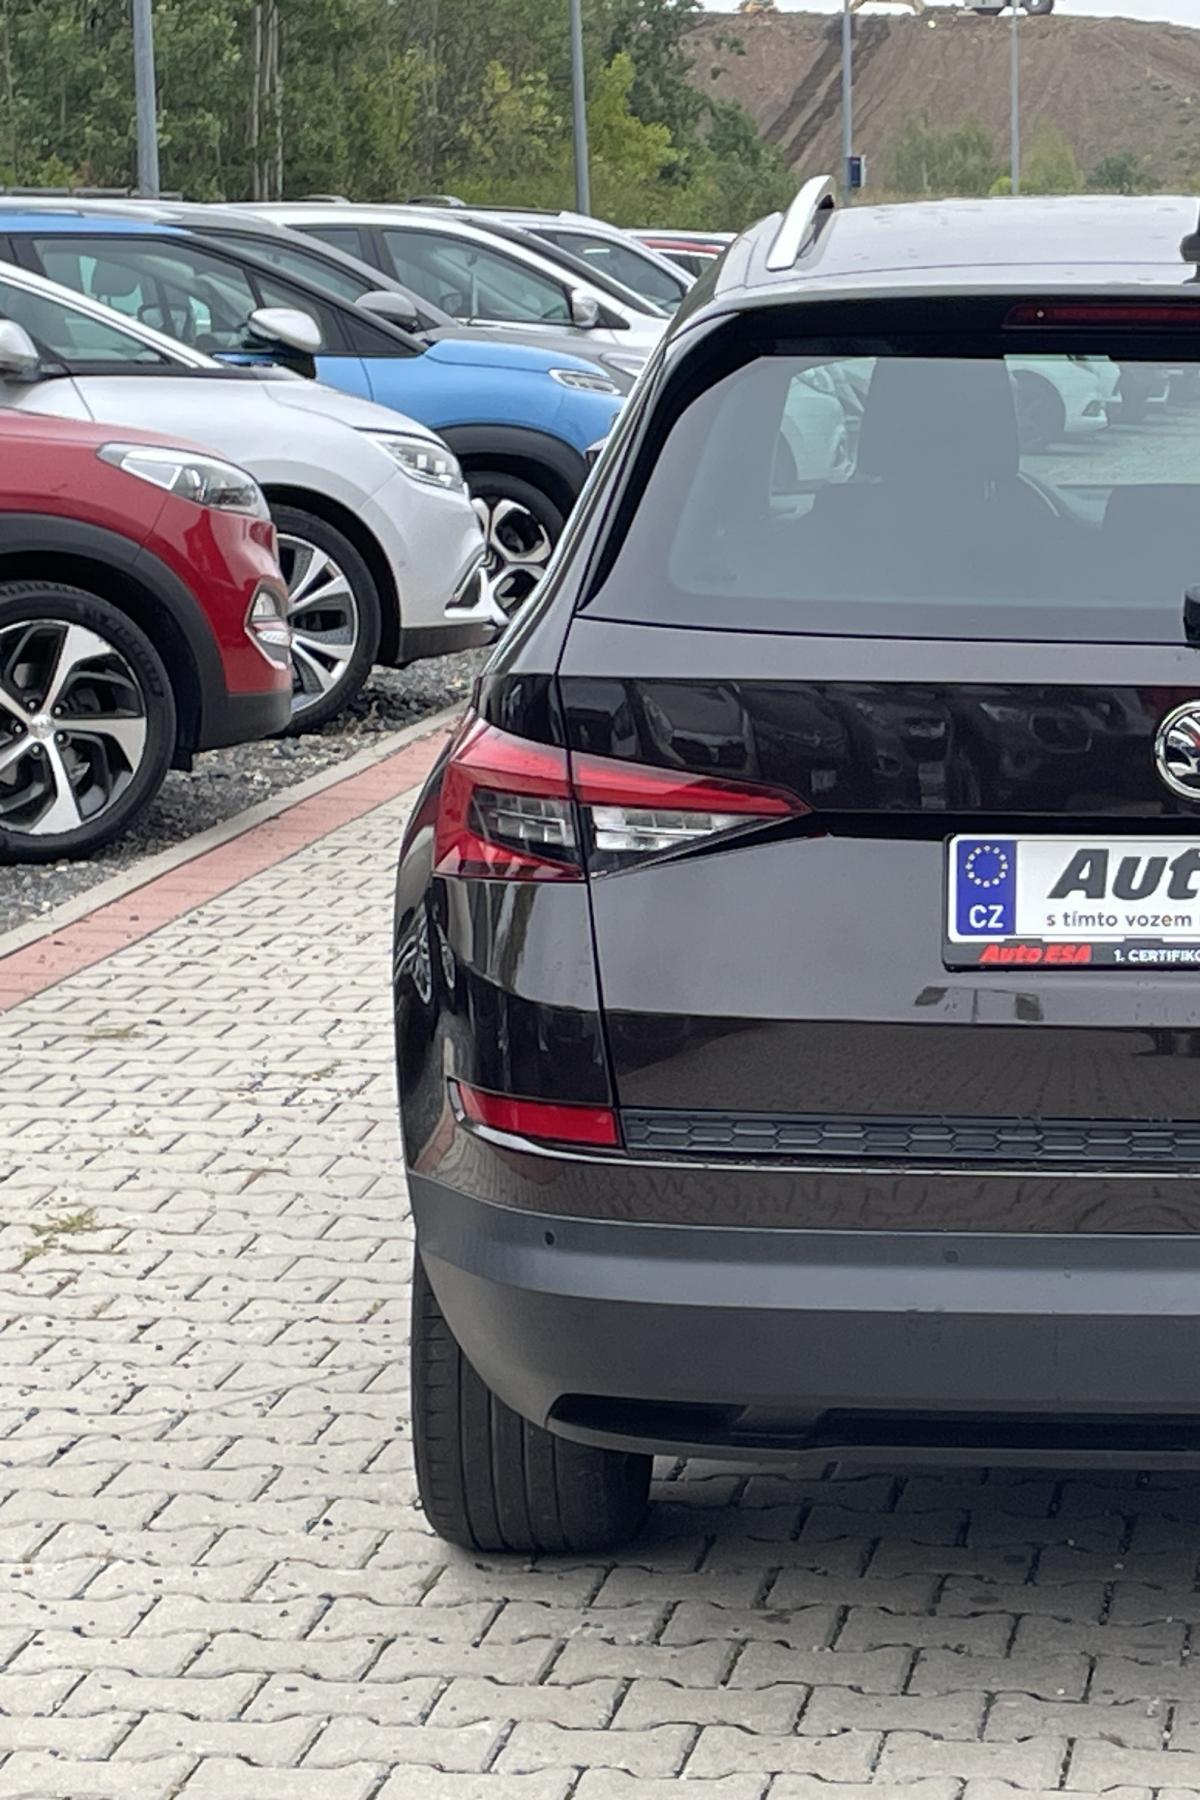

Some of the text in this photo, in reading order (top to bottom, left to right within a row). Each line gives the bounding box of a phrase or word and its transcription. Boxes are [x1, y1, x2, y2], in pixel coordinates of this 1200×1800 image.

[968, 904, 1004, 929] CZ
[1046, 914, 1056, 927] s
[1063, 911, 1118, 928] tímto
[1125, 914, 1192, 928] vozem
[979, 944, 1091, 964] Auto ESA
[1113, 949, 1126, 963] 1.
